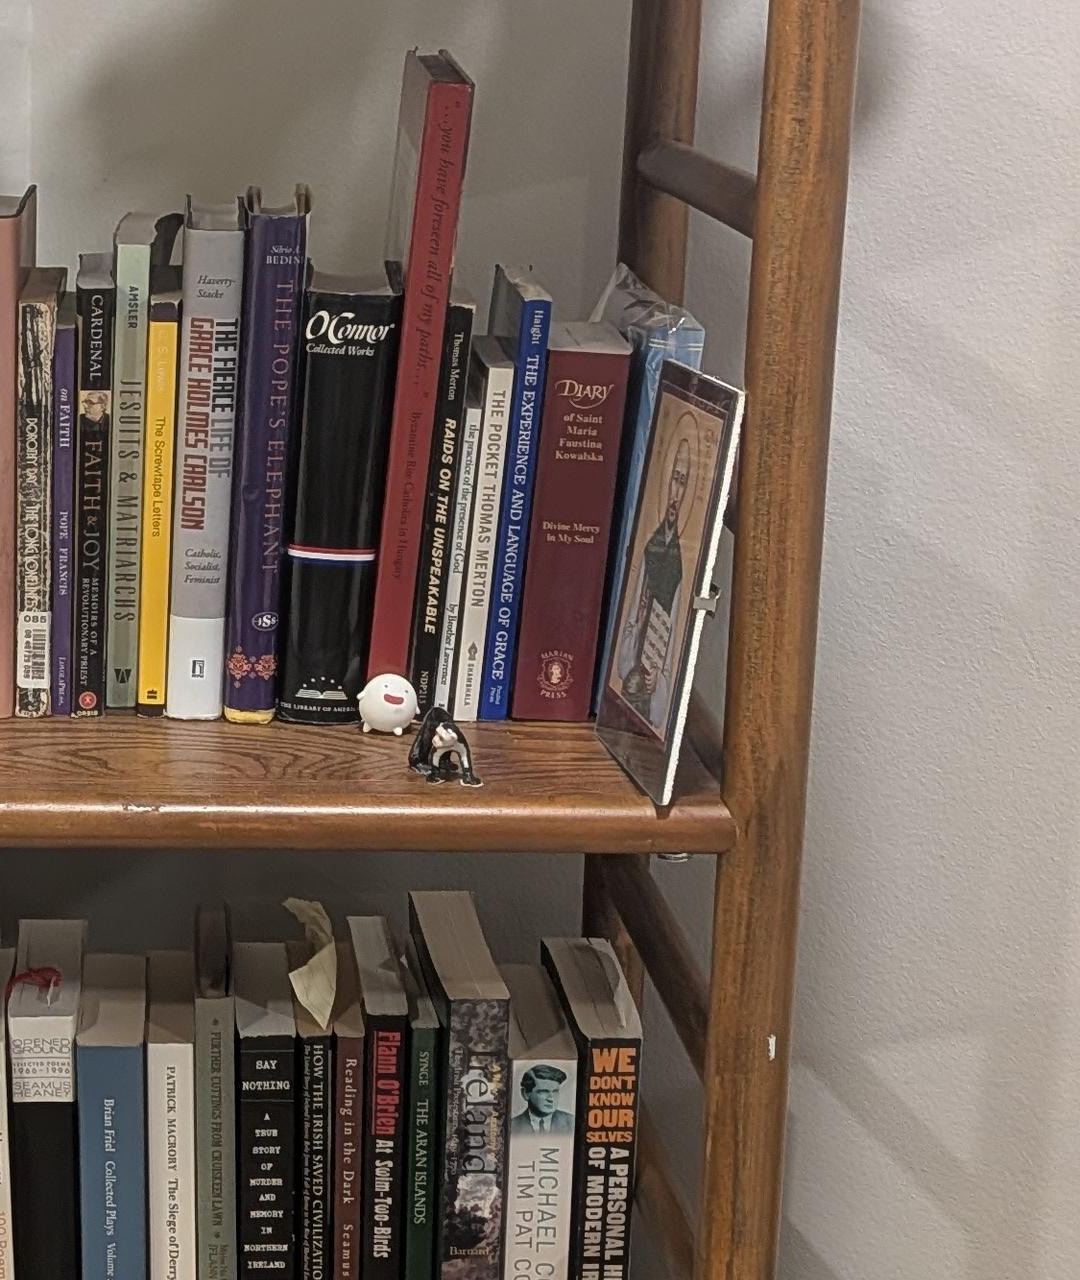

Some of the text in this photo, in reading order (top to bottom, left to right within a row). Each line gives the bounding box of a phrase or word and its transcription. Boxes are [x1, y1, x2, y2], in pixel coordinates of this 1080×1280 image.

[306, 310, 396, 345] O'Connor
[306, 342, 374, 357] Collected Works
[208, 318, 238, 479] THE FIERCE LIFE OF
[555, 379, 615, 409] DIARY
[181, 317, 214, 531] GRACE HOLMES CARLSON
[563, 413, 603, 424] of Saint
[567, 426, 598, 436] Maria
[559, 438, 603, 449] Faustina
[555, 450, 604, 462] Kowalska
[152, 416, 166, 538] The Screwtape Letters
[424, 333, 465, 635] Thomas Merton RAIDS ON THE UNSPEAKABLE
[256, 1060, 278, 1071] SAY
[592, 1048, 636, 1073] WE
[242, 1081, 290, 1091] NOTHING
[590, 1076, 635, 1091] DON'T
[589, 1093, 634, 1107] KNOW
[589, 1110, 634, 1128] OUR
[586, 1131, 632, 1142] SELVES
[589, 1147, 606, 1170] OF
[611, 1147, 628, 1160] A
[517, 1162, 535, 1200] TIM
[534, 1147, 559, 1253] MICHAEL
[606, 1163, 628, 1260] PERSONAL
[583, 1174, 604, 1258] MODERN
[515, 1210, 533, 1250] PAT
